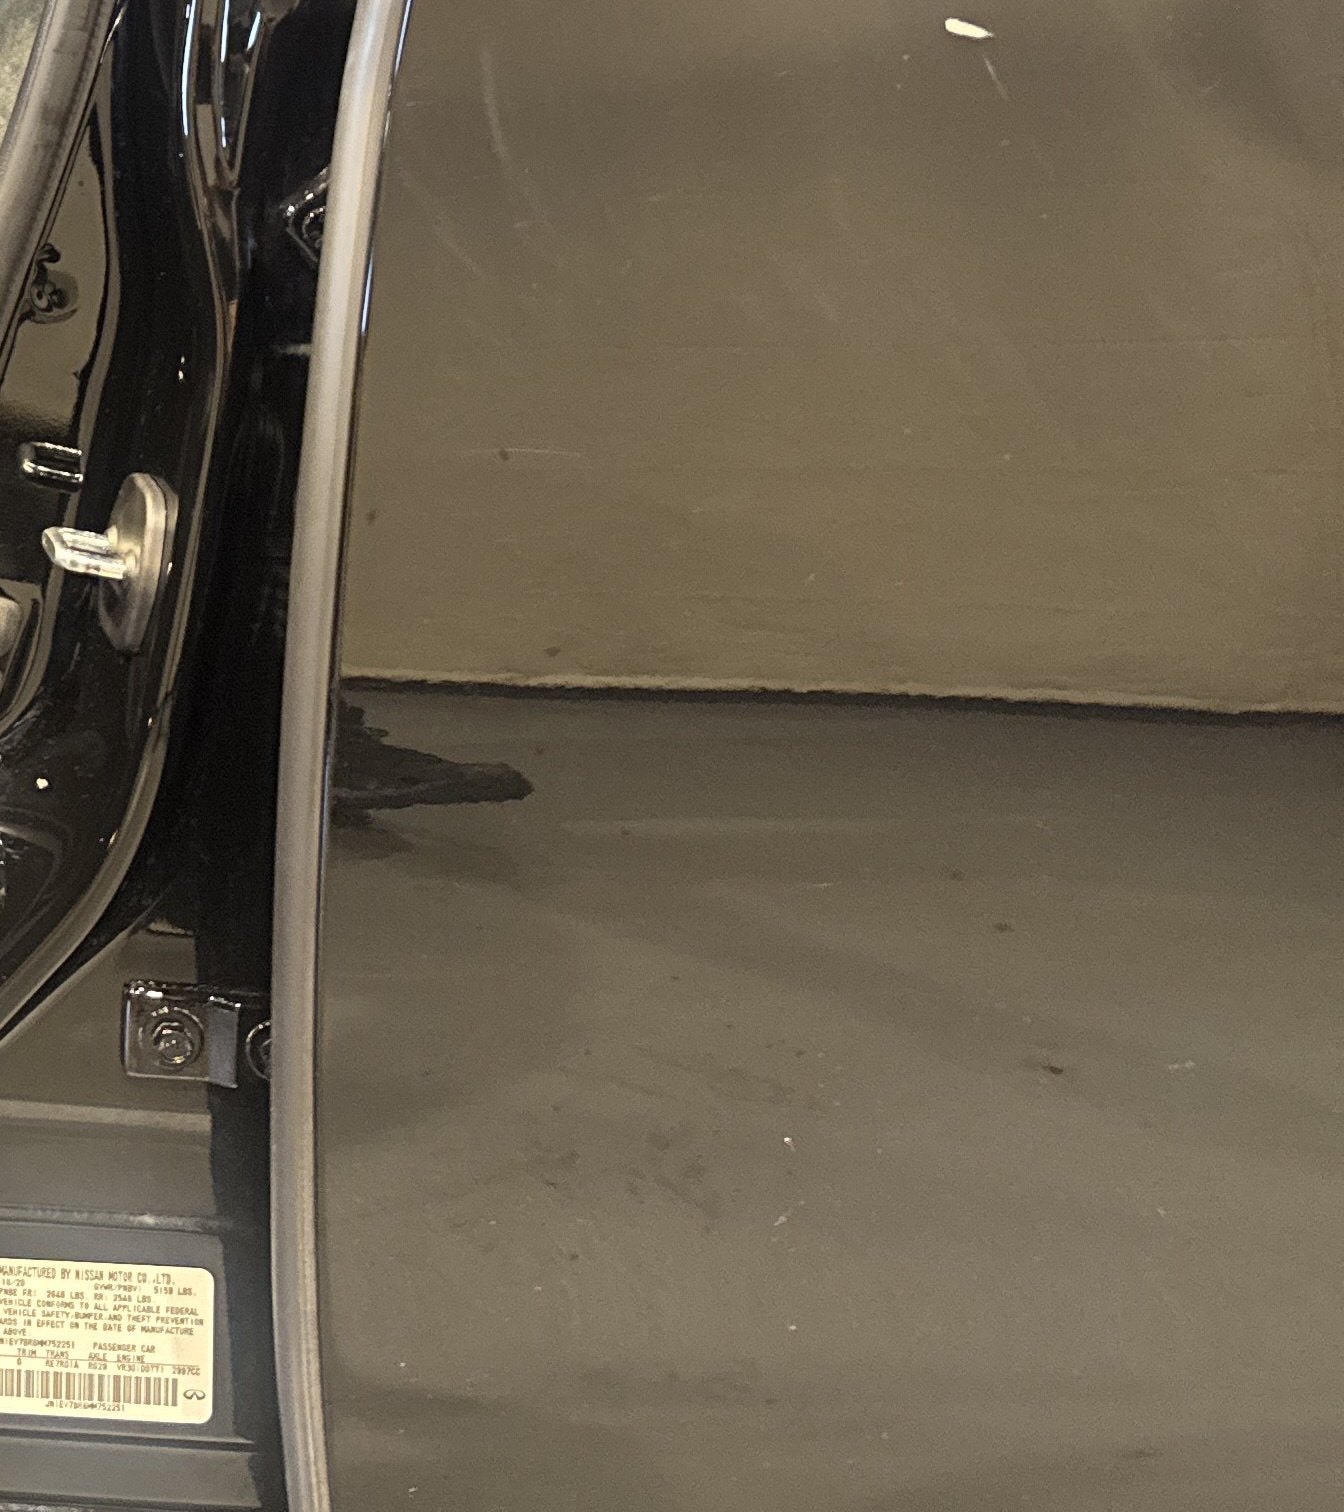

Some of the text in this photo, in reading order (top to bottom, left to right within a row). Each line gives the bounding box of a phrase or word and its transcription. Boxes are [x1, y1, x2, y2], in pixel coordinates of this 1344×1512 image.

[60, 1267, 70, 1280] BY
[74, 1268, 103, 1281] NISSAN
[108, 1269, 132, 1282] MOTOR
[36, 1299, 74, 1309] CONFORMS
[79, 1301, 89, 1310] TO
[93, 1302, 108, 1311] ALL
[112, 1303, 160, 1313] APPLICABLE
[165, 1305, 198, 1315] FEDERAL
[2, 1307, 36, 1317] VEHICLE
[127, 1313, 151, 1323] THEFT
[155, 1314, 203, 1325] PREVENTION
[2, 1327, 26, 1336] ABOVE
[23, 1318, 31, 1327] IN
[36, 1319, 65, 1329] EFFECT
[69, 1320, 79, 1329] ON
[84, 1321, 97, 1330] THE
[102, 1322, 122, 1331] DATE
[126, 1323, 136, 1332] OF
[140, 1323, 194, 1335] MANUFACTURE
[16, 1347, 36, 1357] TRIM
[116, 1352, 145, 1363] ENGINE
[92, 1341, 155, 1353] PASSENGER CAR
